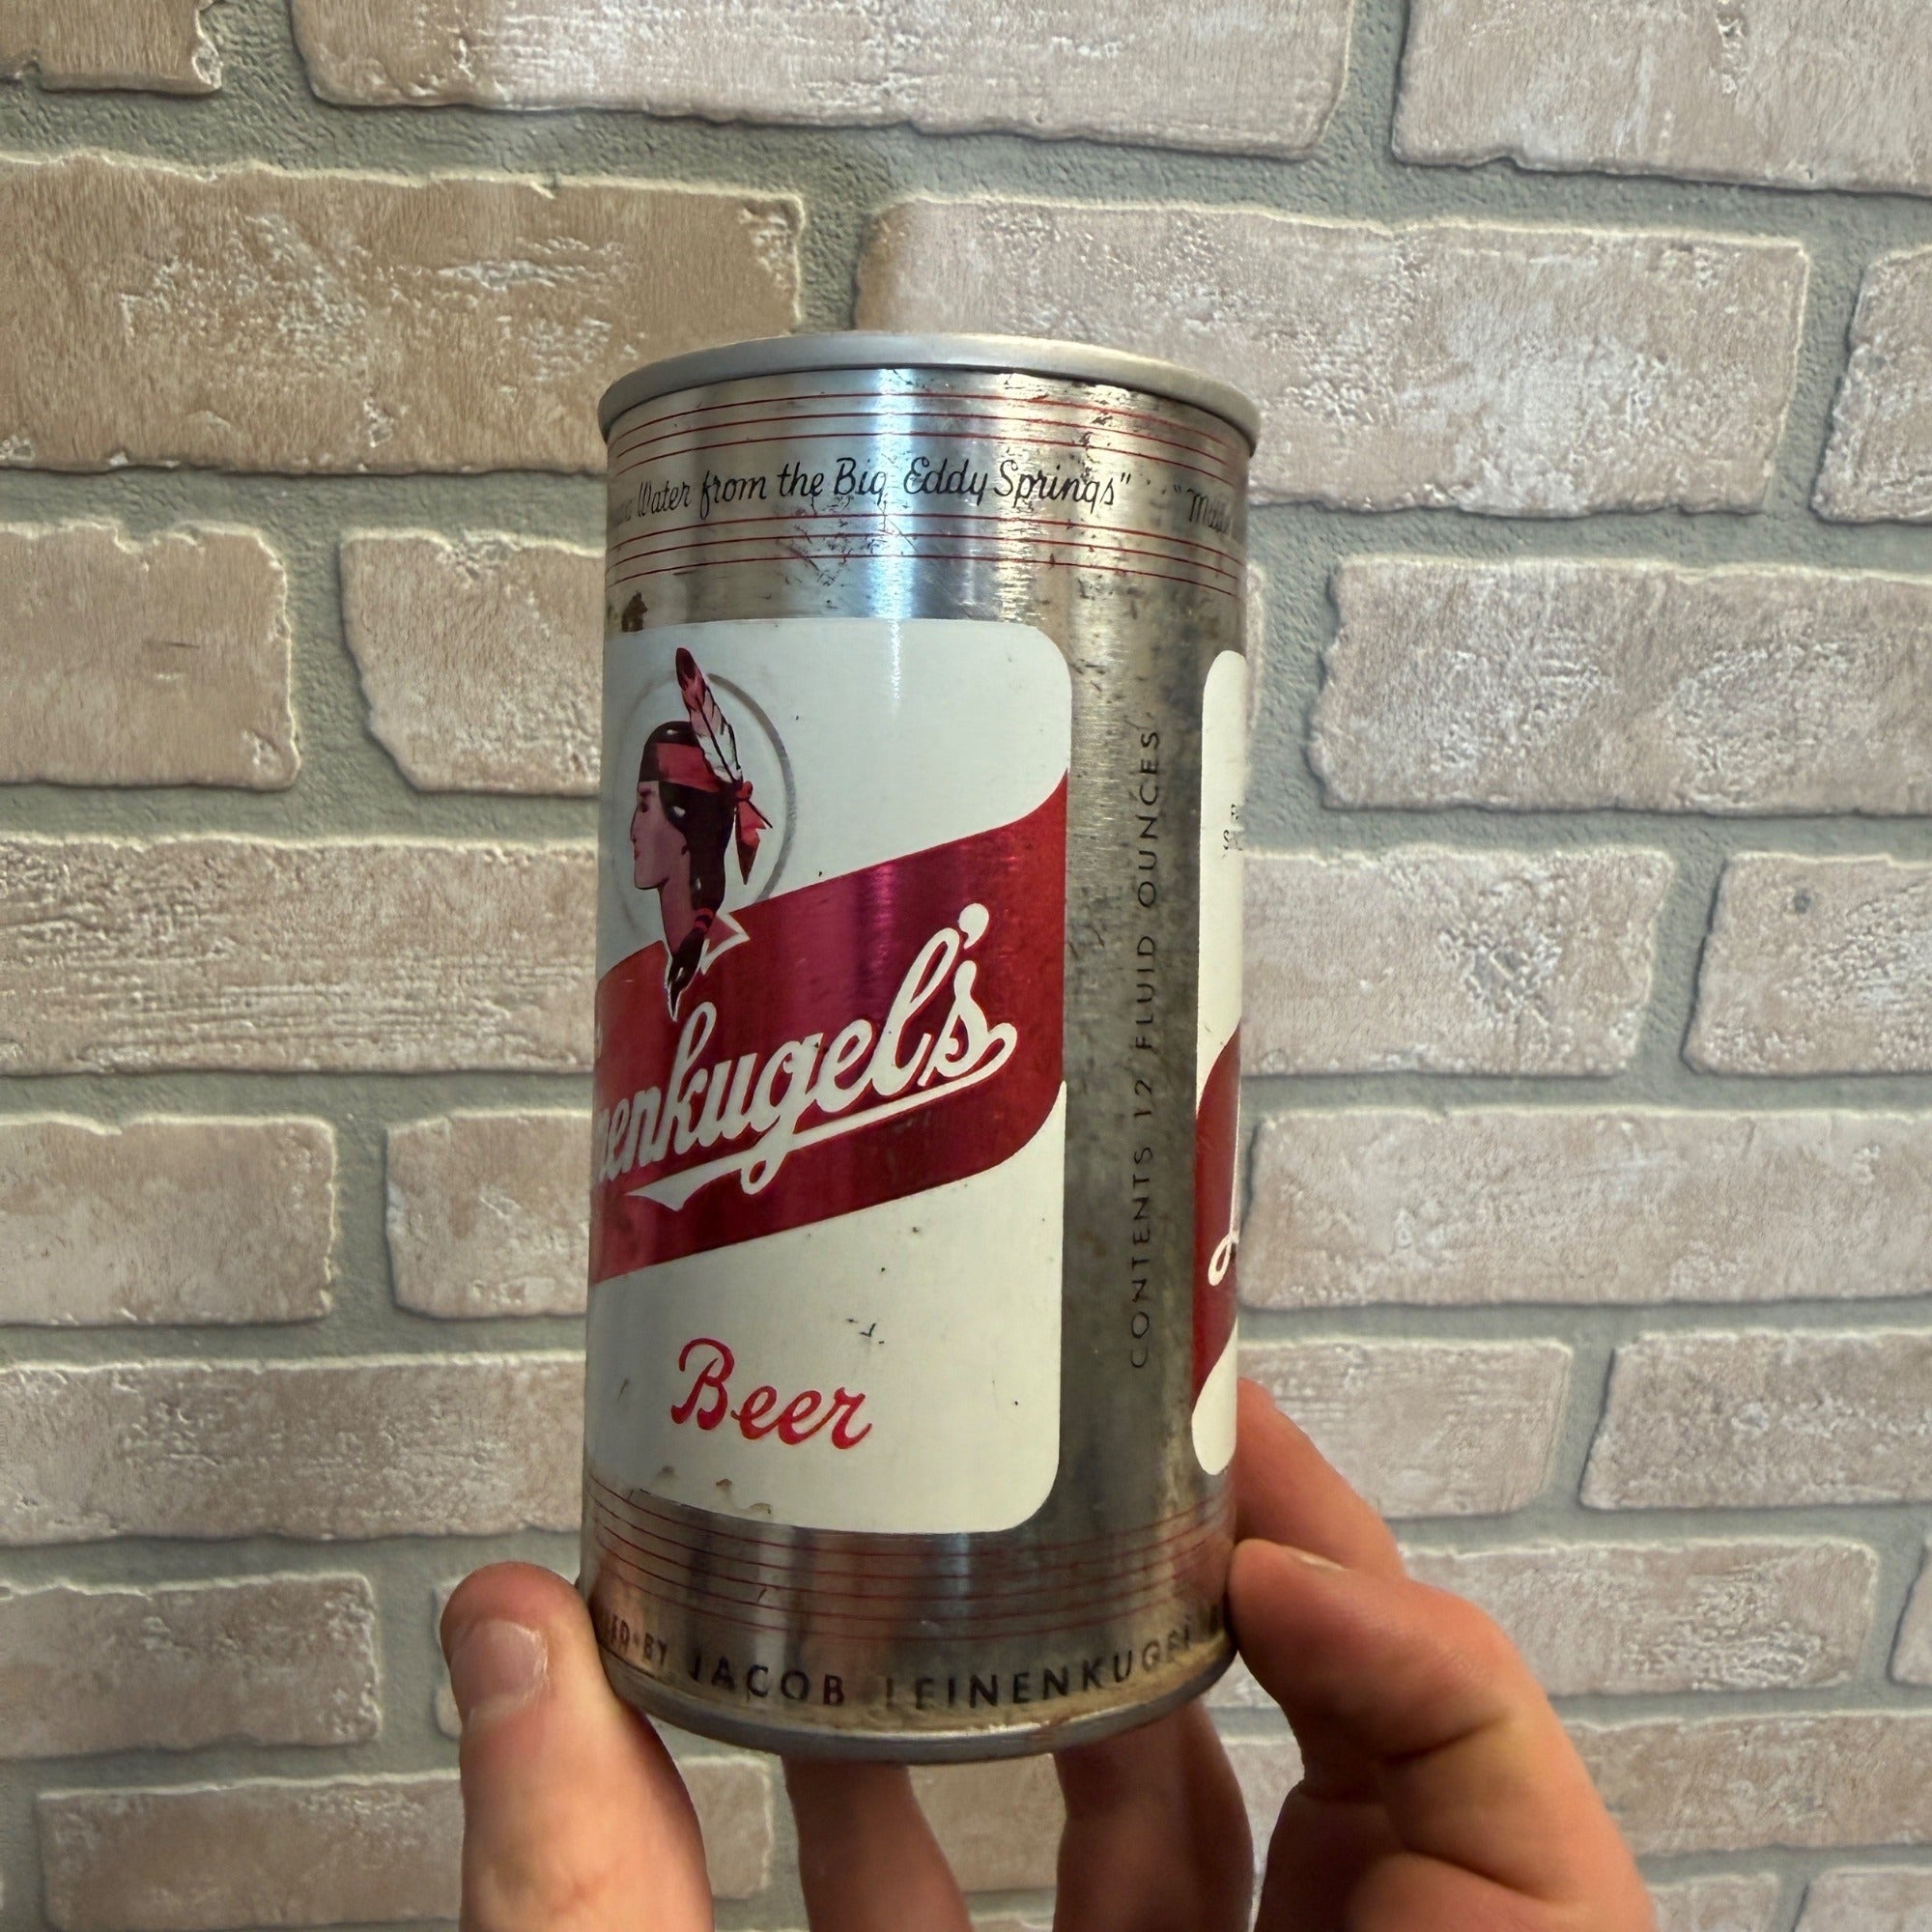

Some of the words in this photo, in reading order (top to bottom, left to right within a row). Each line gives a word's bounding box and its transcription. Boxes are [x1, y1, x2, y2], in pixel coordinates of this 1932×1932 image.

[637, 479, 693, 518] Water
[699, 469, 768, 521] from
[777, 460, 824, 497] the
[833, 456, 888, 506] Big
[902, 456, 989, 507] Eddy
[993, 458, 1132, 514] Springs"
[1136, 730, 1160, 908] OUNCES
[1135, 936, 1156, 1050] FLUID
[1133, 1079, 1152, 1119] 12
[1130, 1146, 1154, 1369] CONTENTS
[670, 1336, 873, 1450] Beer
[688, 1646, 845, 1708] JACOB
